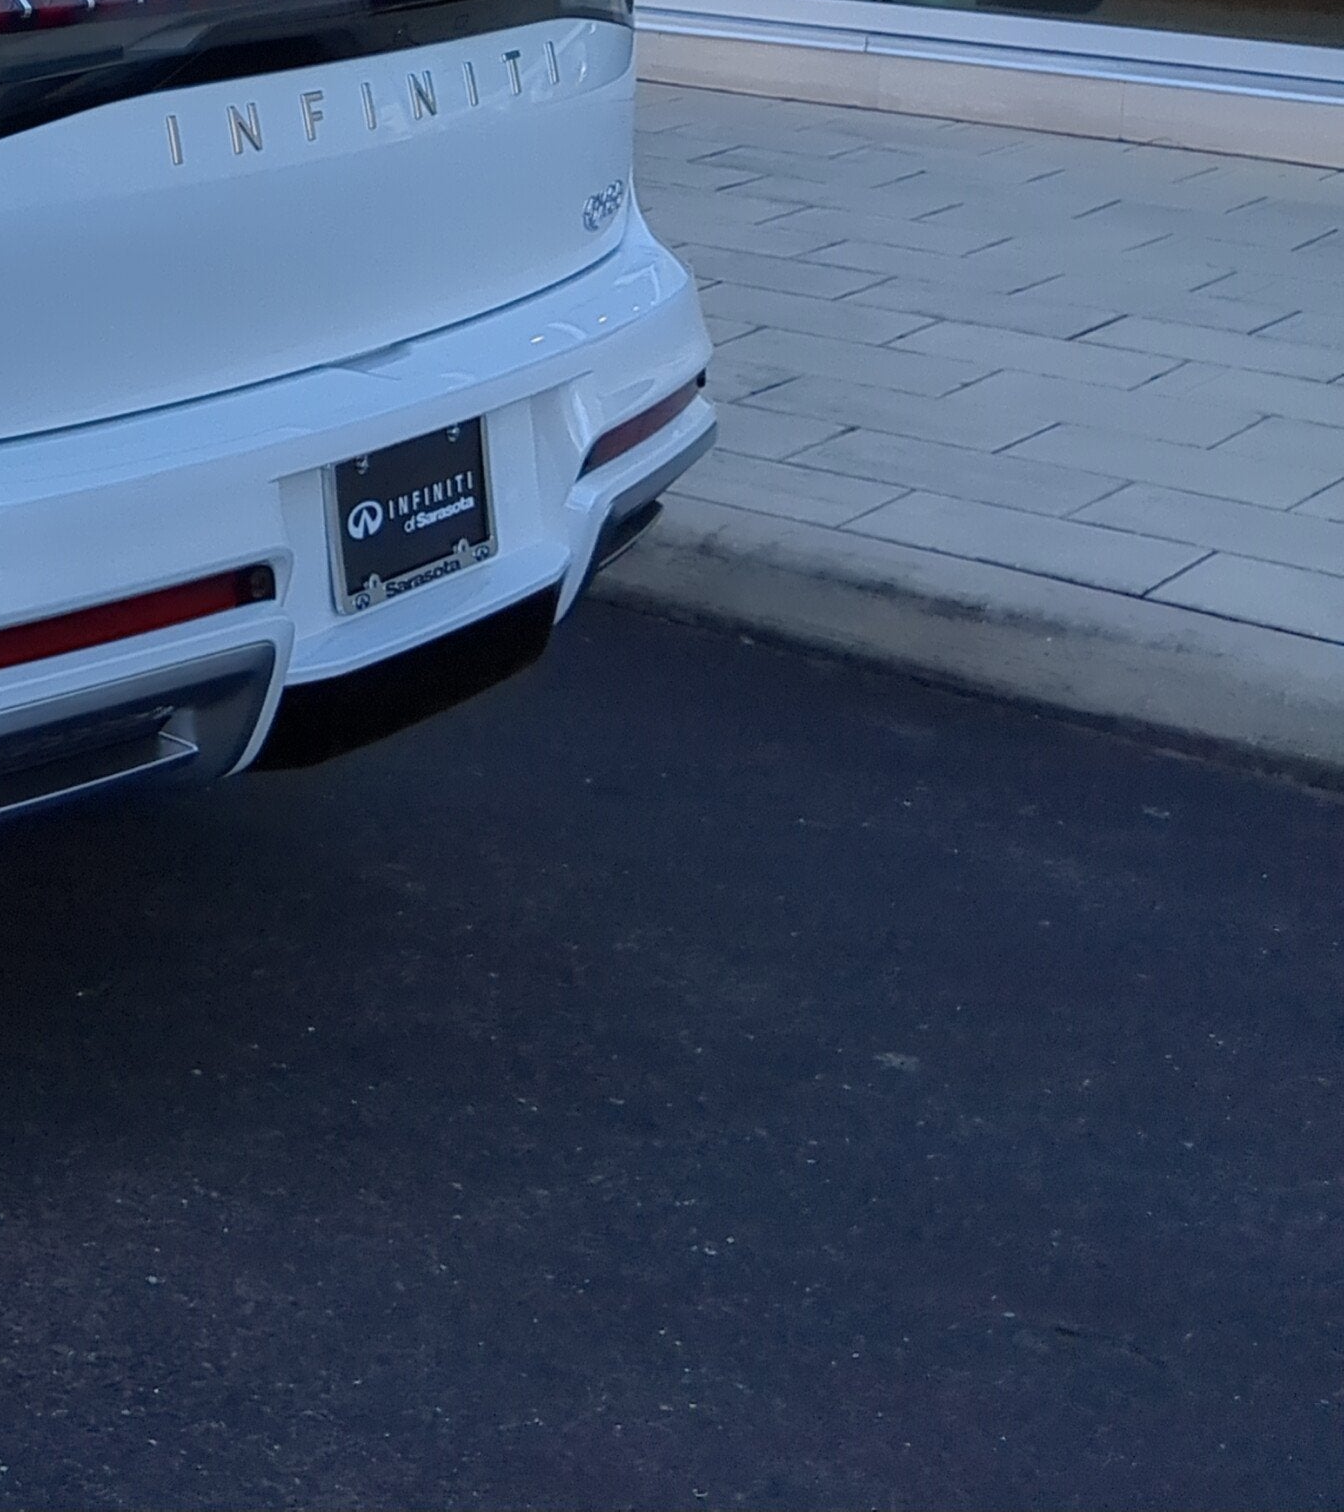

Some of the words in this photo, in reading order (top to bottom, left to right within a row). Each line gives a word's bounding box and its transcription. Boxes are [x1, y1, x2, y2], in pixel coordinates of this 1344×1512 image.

[165, 41, 559, 165] INFINITI
[388, 471, 473, 519] INFINITI
[404, 515, 416, 533] of
[416, 496, 475, 528] Sarasota
[385, 558, 461, 598] Sarasota
